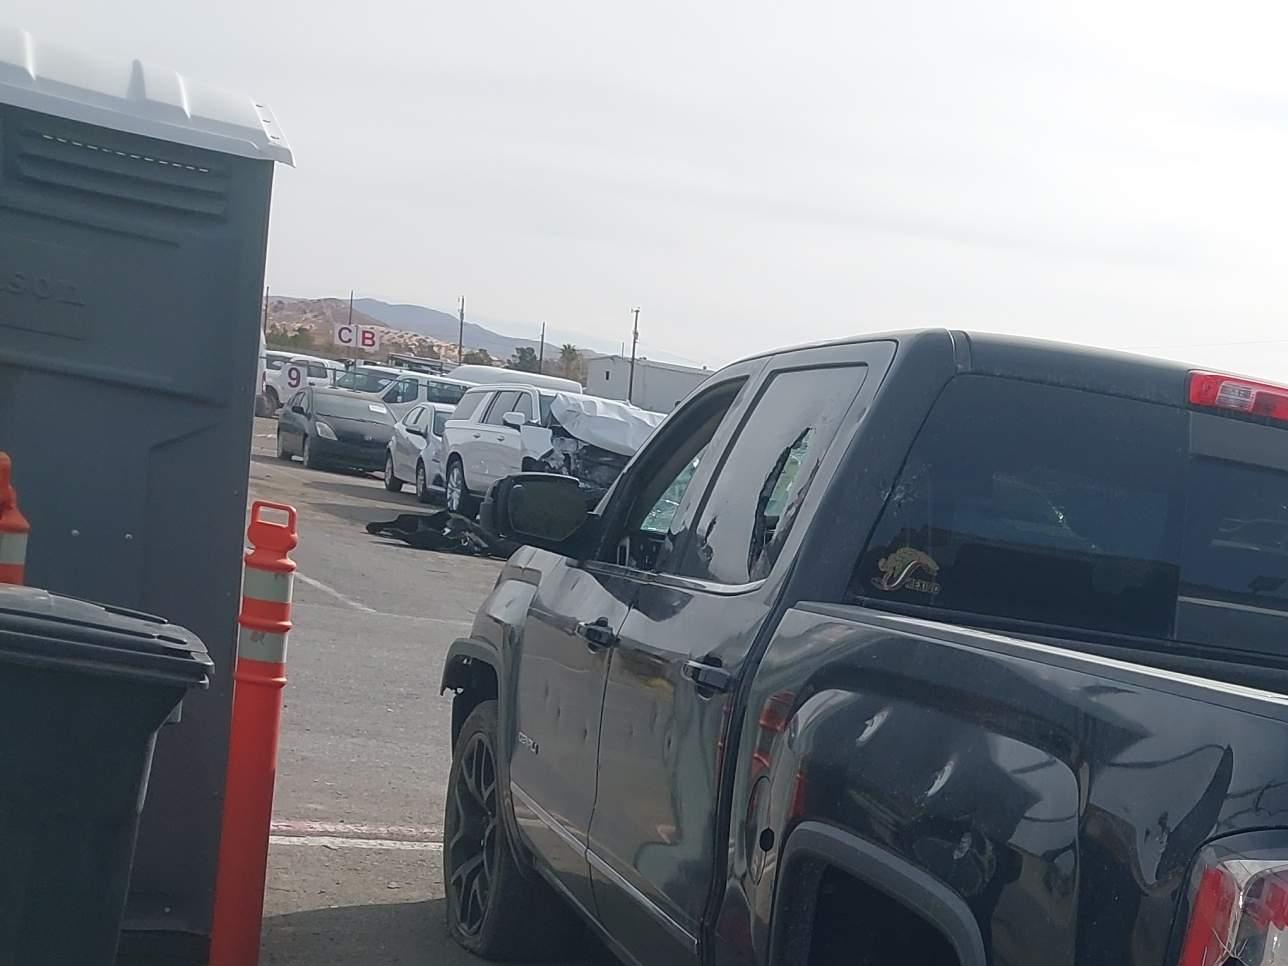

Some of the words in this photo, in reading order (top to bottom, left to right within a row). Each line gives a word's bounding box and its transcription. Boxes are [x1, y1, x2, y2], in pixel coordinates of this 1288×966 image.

[338, 327, 352, 343] C
[362, 330, 375, 347] B
[288, 367, 301, 388] 9
